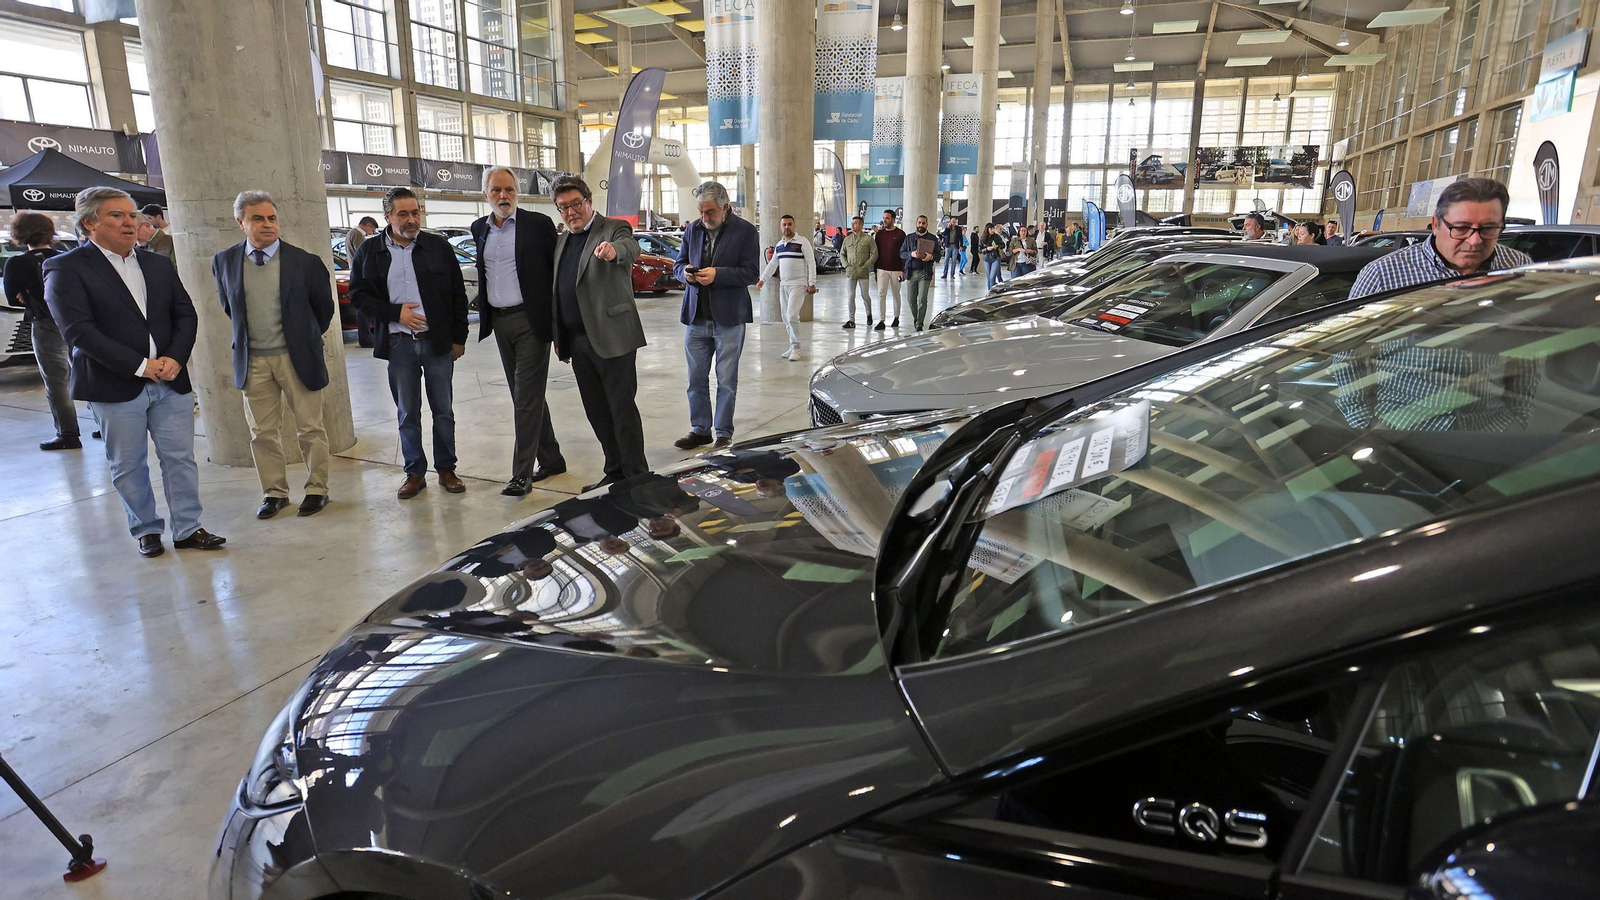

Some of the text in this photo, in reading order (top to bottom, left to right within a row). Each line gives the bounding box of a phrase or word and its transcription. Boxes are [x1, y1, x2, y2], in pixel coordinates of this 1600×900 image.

[709, 0, 755, 13] IFECA
[1545, 51, 1566, 68] PUERTA
[876, 84, 903, 94] FECA
[946, 81, 979, 90] IFECA
[69, 145, 116, 156] NIMAUTO
[614, 150, 647, 163] NIMAUTO
[453, 173, 473, 181] NIMAUTO
[1132, 797, 1268, 848] EQS
